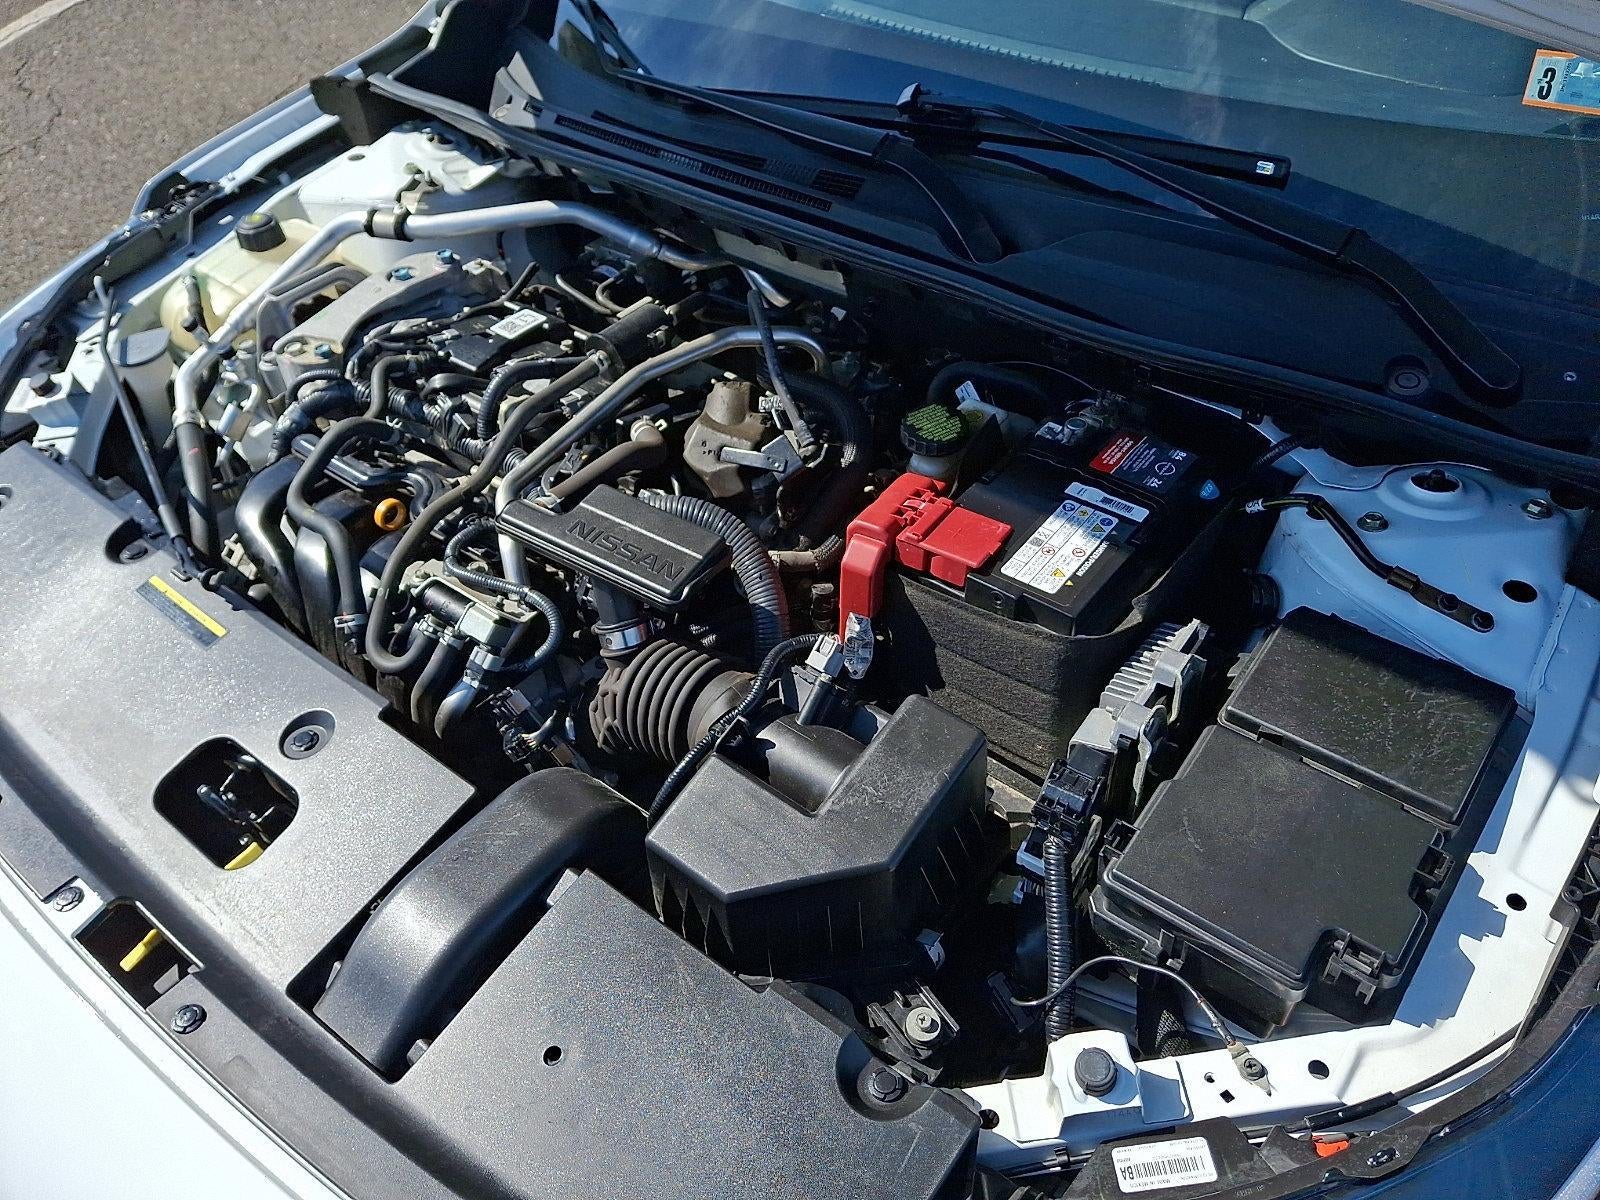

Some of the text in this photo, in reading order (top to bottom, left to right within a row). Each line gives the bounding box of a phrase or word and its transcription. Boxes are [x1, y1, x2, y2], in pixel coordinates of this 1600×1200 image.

[1537, 67, 1556, 100] 3
[566, 519, 685, 581] NISSAN
[1119, 1165, 1135, 1181] BA
